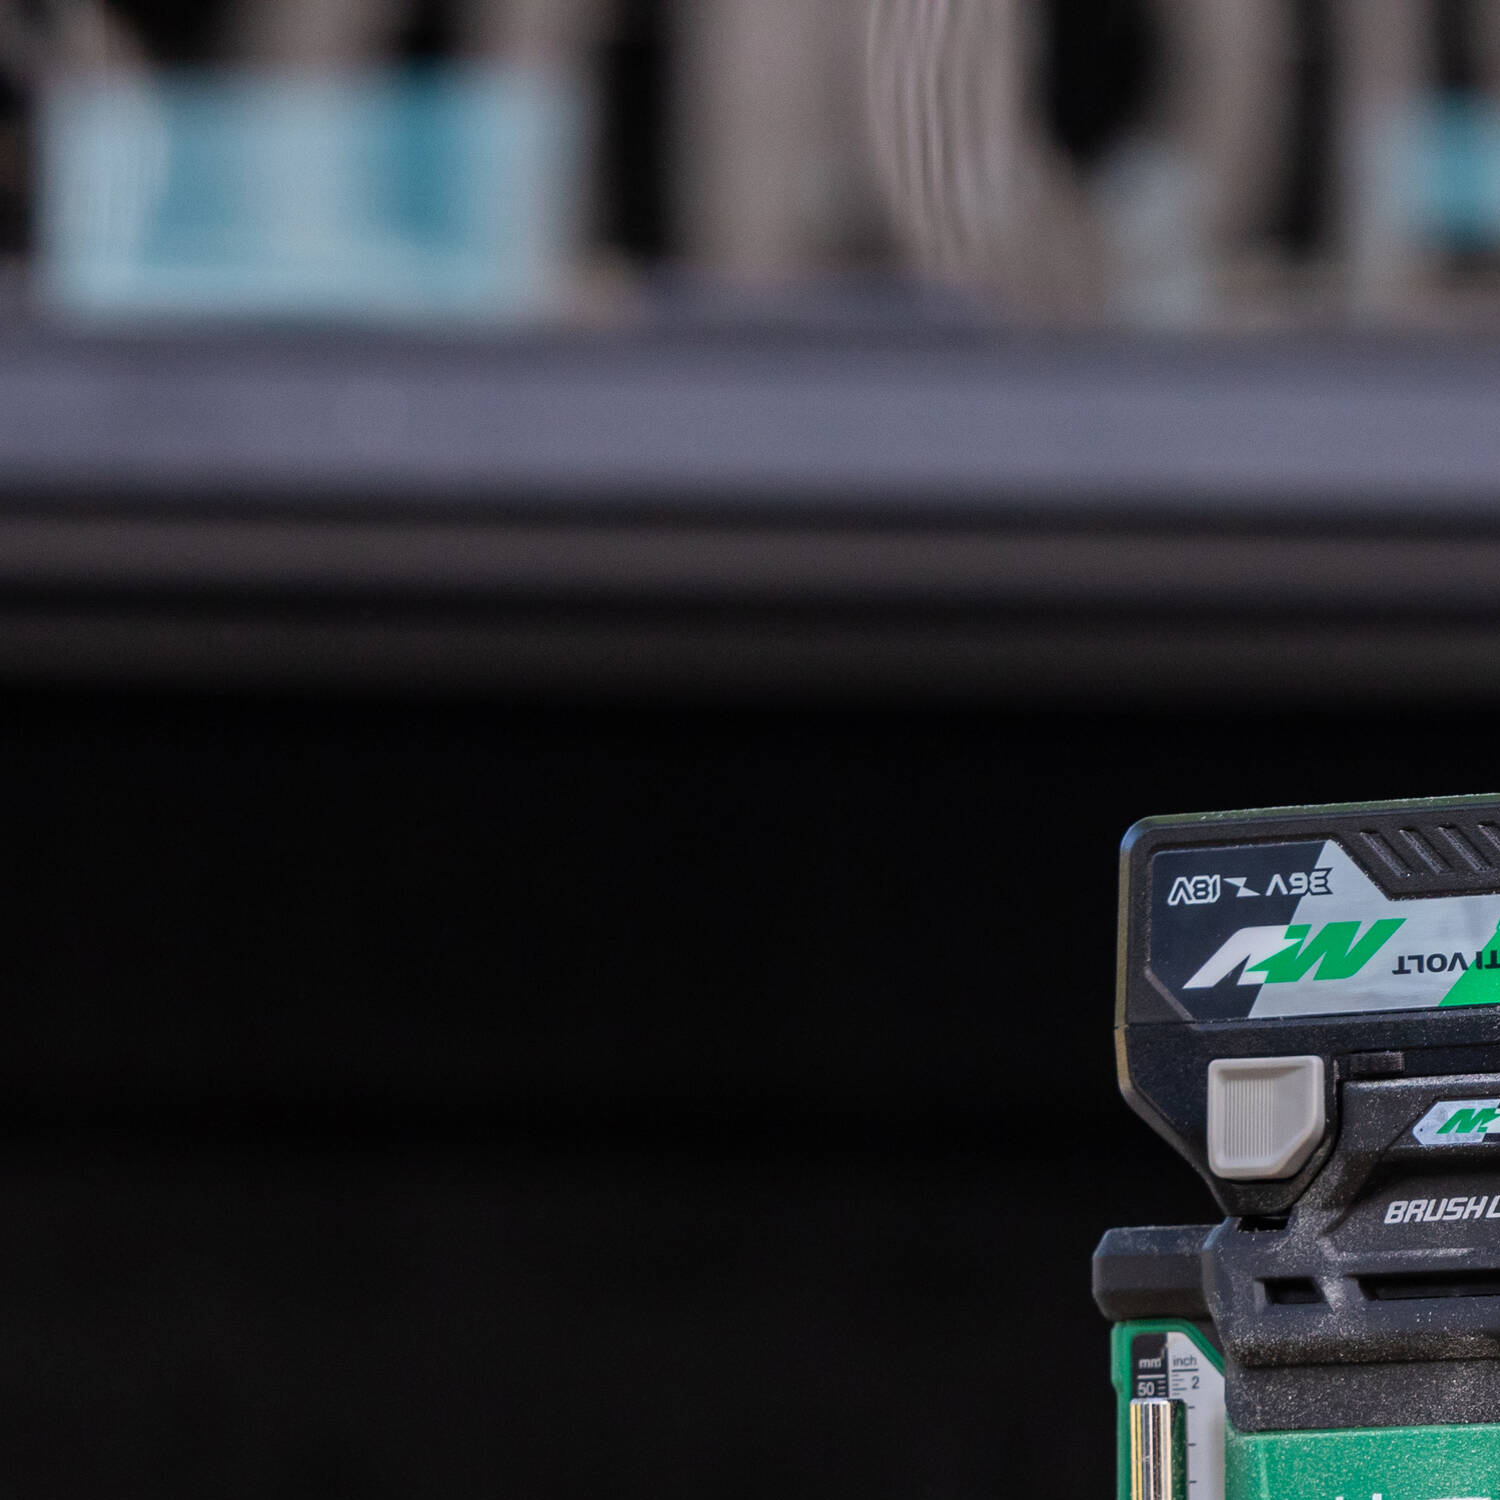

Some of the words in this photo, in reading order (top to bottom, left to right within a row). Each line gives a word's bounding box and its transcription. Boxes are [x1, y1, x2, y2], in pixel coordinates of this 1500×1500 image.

[1167, 874, 1221, 906] 18V
[1265, 867, 1334, 896] 36V
[1391, 952, 1469, 975] VOLT
[1173, 1355, 1198, 1367] inch
[1137, 1381, 1155, 1397] 50
[1191, 1375, 1200, 1391] 2
